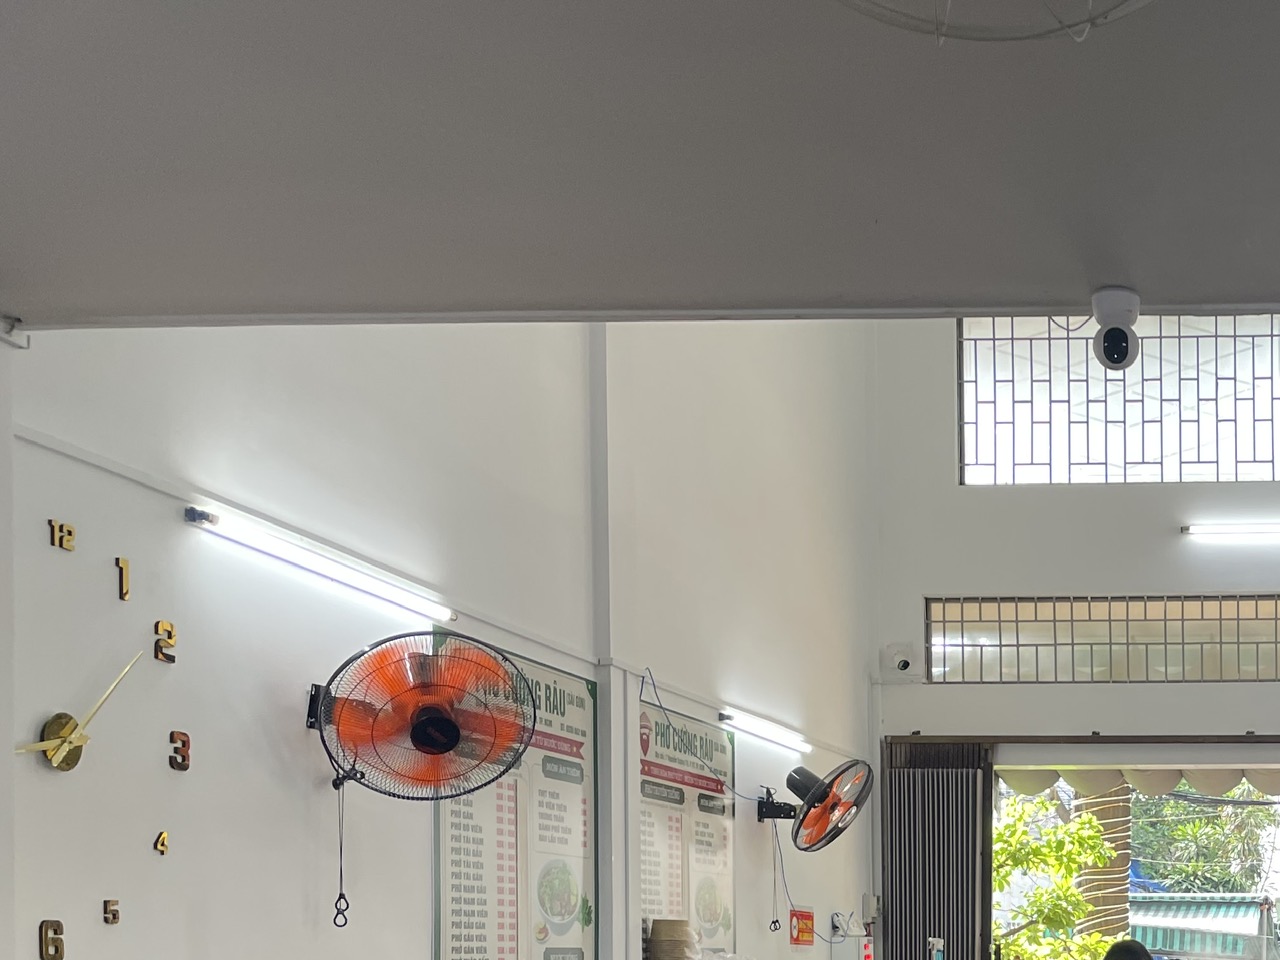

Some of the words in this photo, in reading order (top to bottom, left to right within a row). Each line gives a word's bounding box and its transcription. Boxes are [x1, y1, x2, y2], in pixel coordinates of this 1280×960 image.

[47, 519, 76, 551] 12
[115, 557, 130, 601] 1
[154, 620, 176, 663] 2
[545, 680, 566, 717] RÂU
[169, 731, 190, 771] 3
[153, 831, 168, 855] 4
[103, 899, 119, 924] 5
